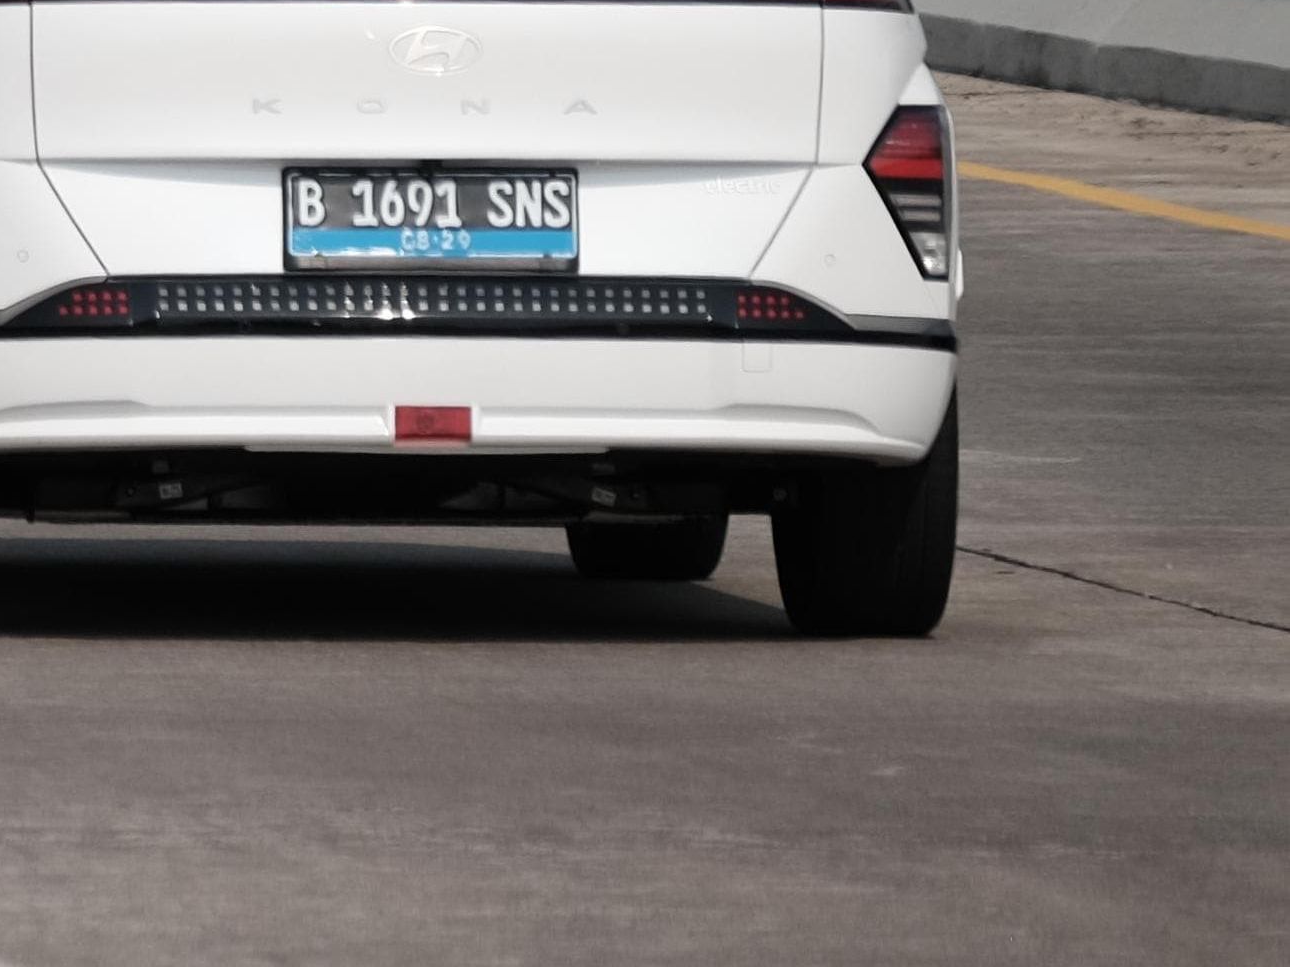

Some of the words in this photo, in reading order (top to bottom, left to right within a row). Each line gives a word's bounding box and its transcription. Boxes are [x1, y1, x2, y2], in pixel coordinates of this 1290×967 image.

[299, 179, 325, 227] B
[352, 179, 463, 229] 1691
[487, 180, 571, 229] SNS
